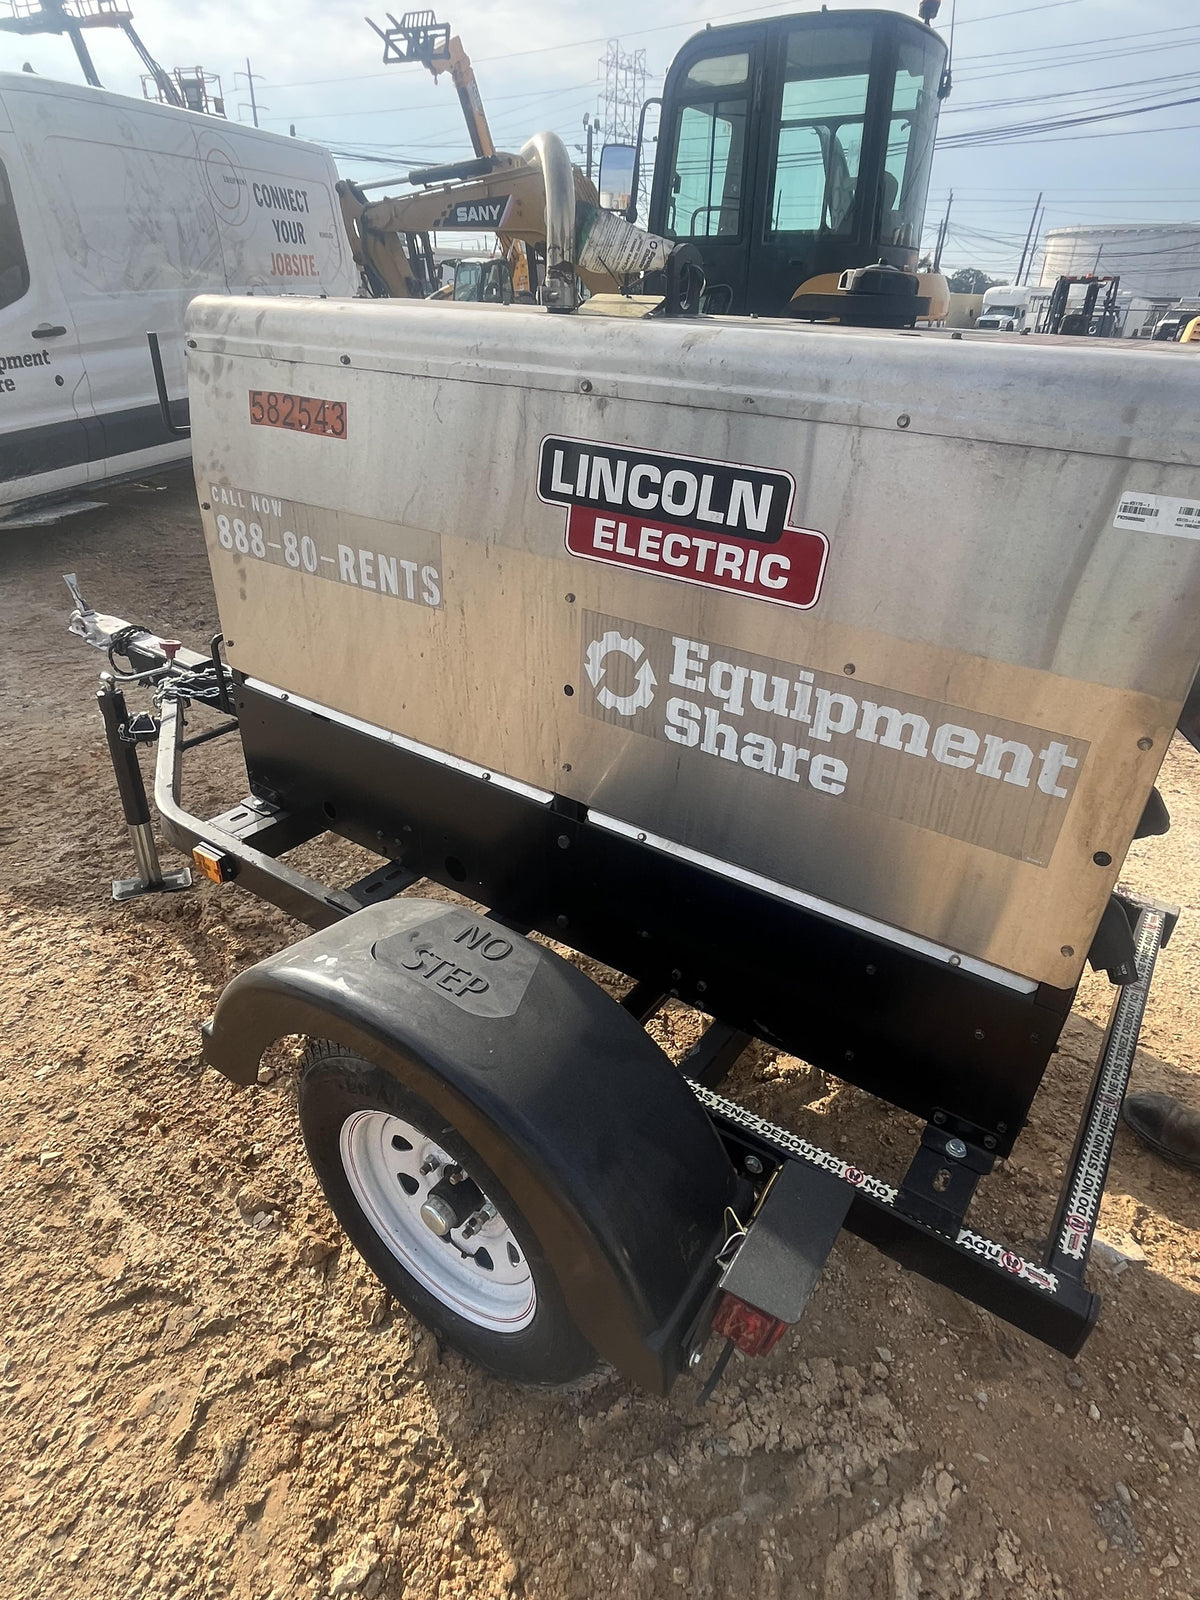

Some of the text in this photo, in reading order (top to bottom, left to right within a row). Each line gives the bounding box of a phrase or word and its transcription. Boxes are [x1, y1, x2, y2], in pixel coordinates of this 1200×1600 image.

[253, 183, 310, 213] CONNECT
[456, 204, 500, 222] SANY
[272, 219, 306, 245] YOUR
[270, 253, 320, 277] JOBSITE.
[252, 391, 345, 436] 582543
[211, 486, 282, 517] CALL NOW
[551, 450, 774, 533] LINCOLN
[217, 514, 441, 605] 888-80-RENTS
[593, 517, 791, 590] ELECTRIC
[668, 635, 1078, 799] Equipment
[664, 696, 849, 796] Share
[453, 926, 514, 961] NO
[1139, 944, 1150, 963] PARE
[401, 946, 490, 997] STEP
[1121, 1002, 1136, 1033] DEBOUT
[1115, 1034, 1129, 1063] TENEZ
[1110, 1062, 1123, 1082] PAS
[1107, 1080, 1119, 1096] NE
[714, 1099, 759, 1126] TENEZ
[760, 1123, 823, 1159] DEBOUT
[822, 1156, 843, 1172] ICI
[1076, 1105, 1113, 1217] DO NOT STAND HERE
[864, 1179, 889, 1197] NO
